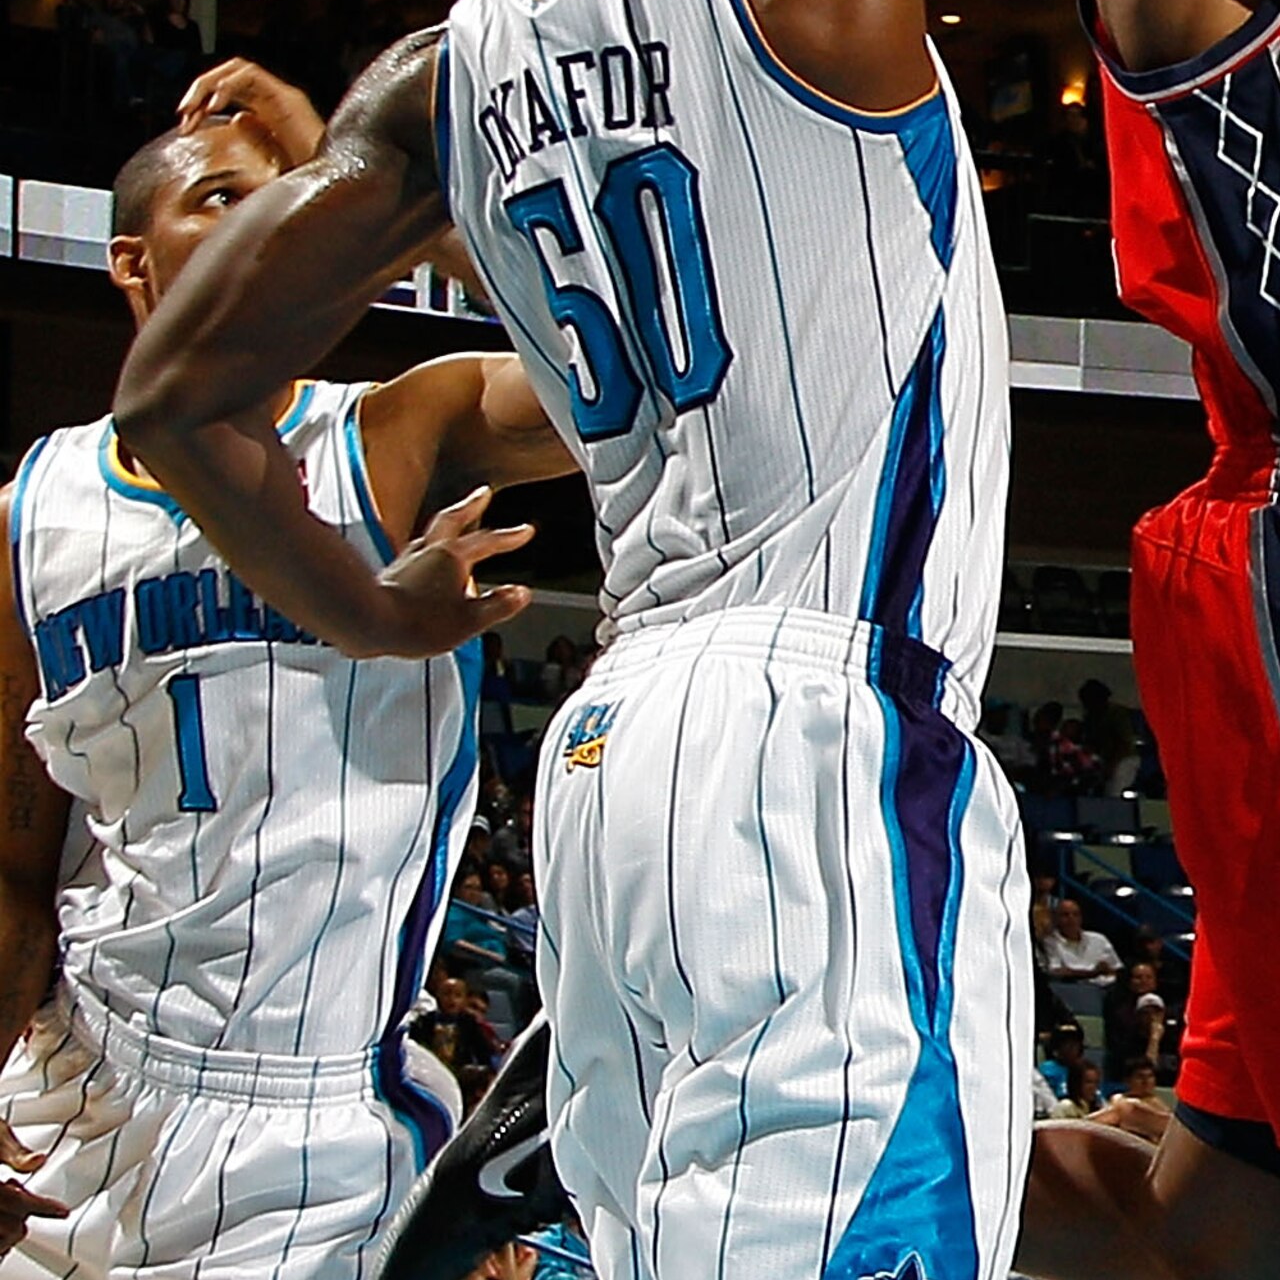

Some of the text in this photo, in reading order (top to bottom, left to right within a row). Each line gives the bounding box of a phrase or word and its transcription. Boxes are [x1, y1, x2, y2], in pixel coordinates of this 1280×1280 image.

[479, 41, 675, 184] OKAFOR
[503, 141, 736, 445] 50
[36, 587, 127, 703] NEW
[168, 672, 217, 812] 1
